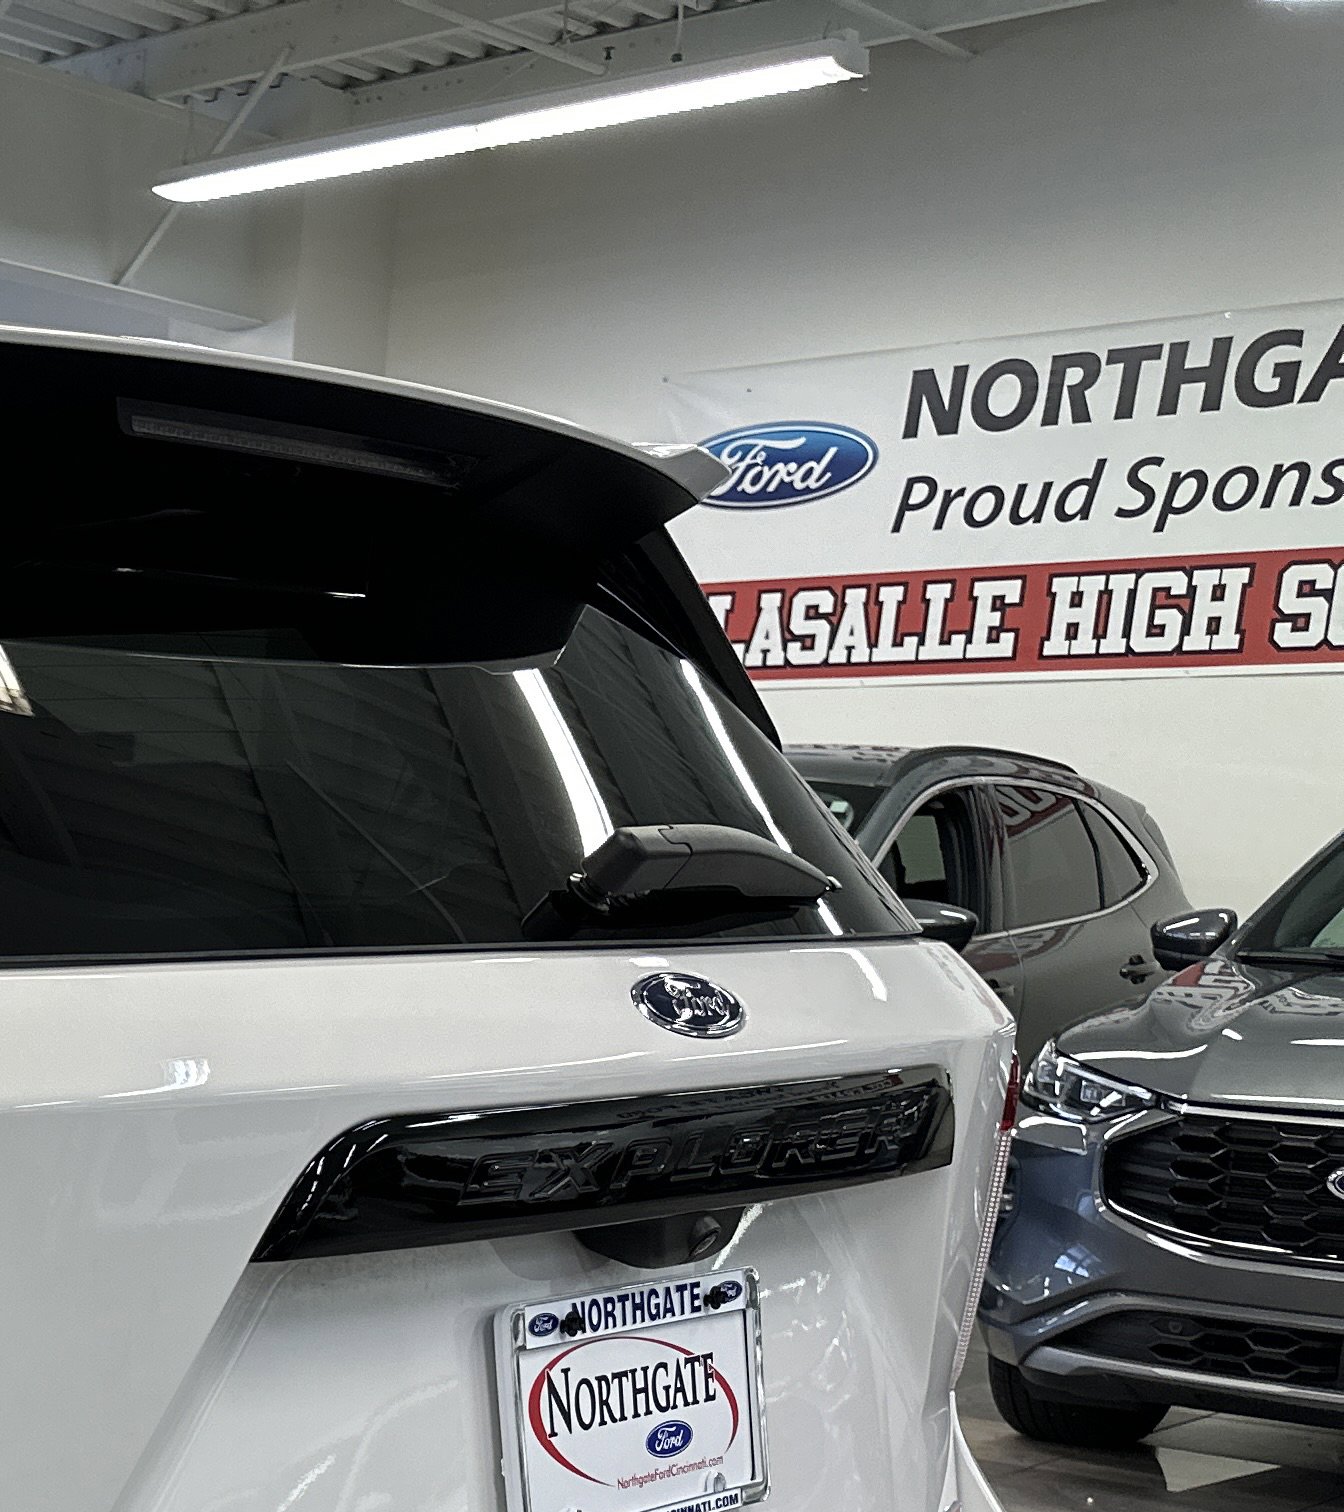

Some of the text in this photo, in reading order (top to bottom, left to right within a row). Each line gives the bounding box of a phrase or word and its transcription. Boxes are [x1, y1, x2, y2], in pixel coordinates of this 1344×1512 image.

[710, 436, 839, 497] Ford
[891, 455, 1344, 533] Proud Spons
[708, 575, 1026, 669] LASALLE
[1037, 562, 1256, 659] HIGH
[458, 1090, 930, 1206] EXPLORER
[571, 1281, 702, 1334] NORTHGATE
[546, 1352, 716, 1438] NORTHGATE
[655, 1426, 683, 1451] Ford
